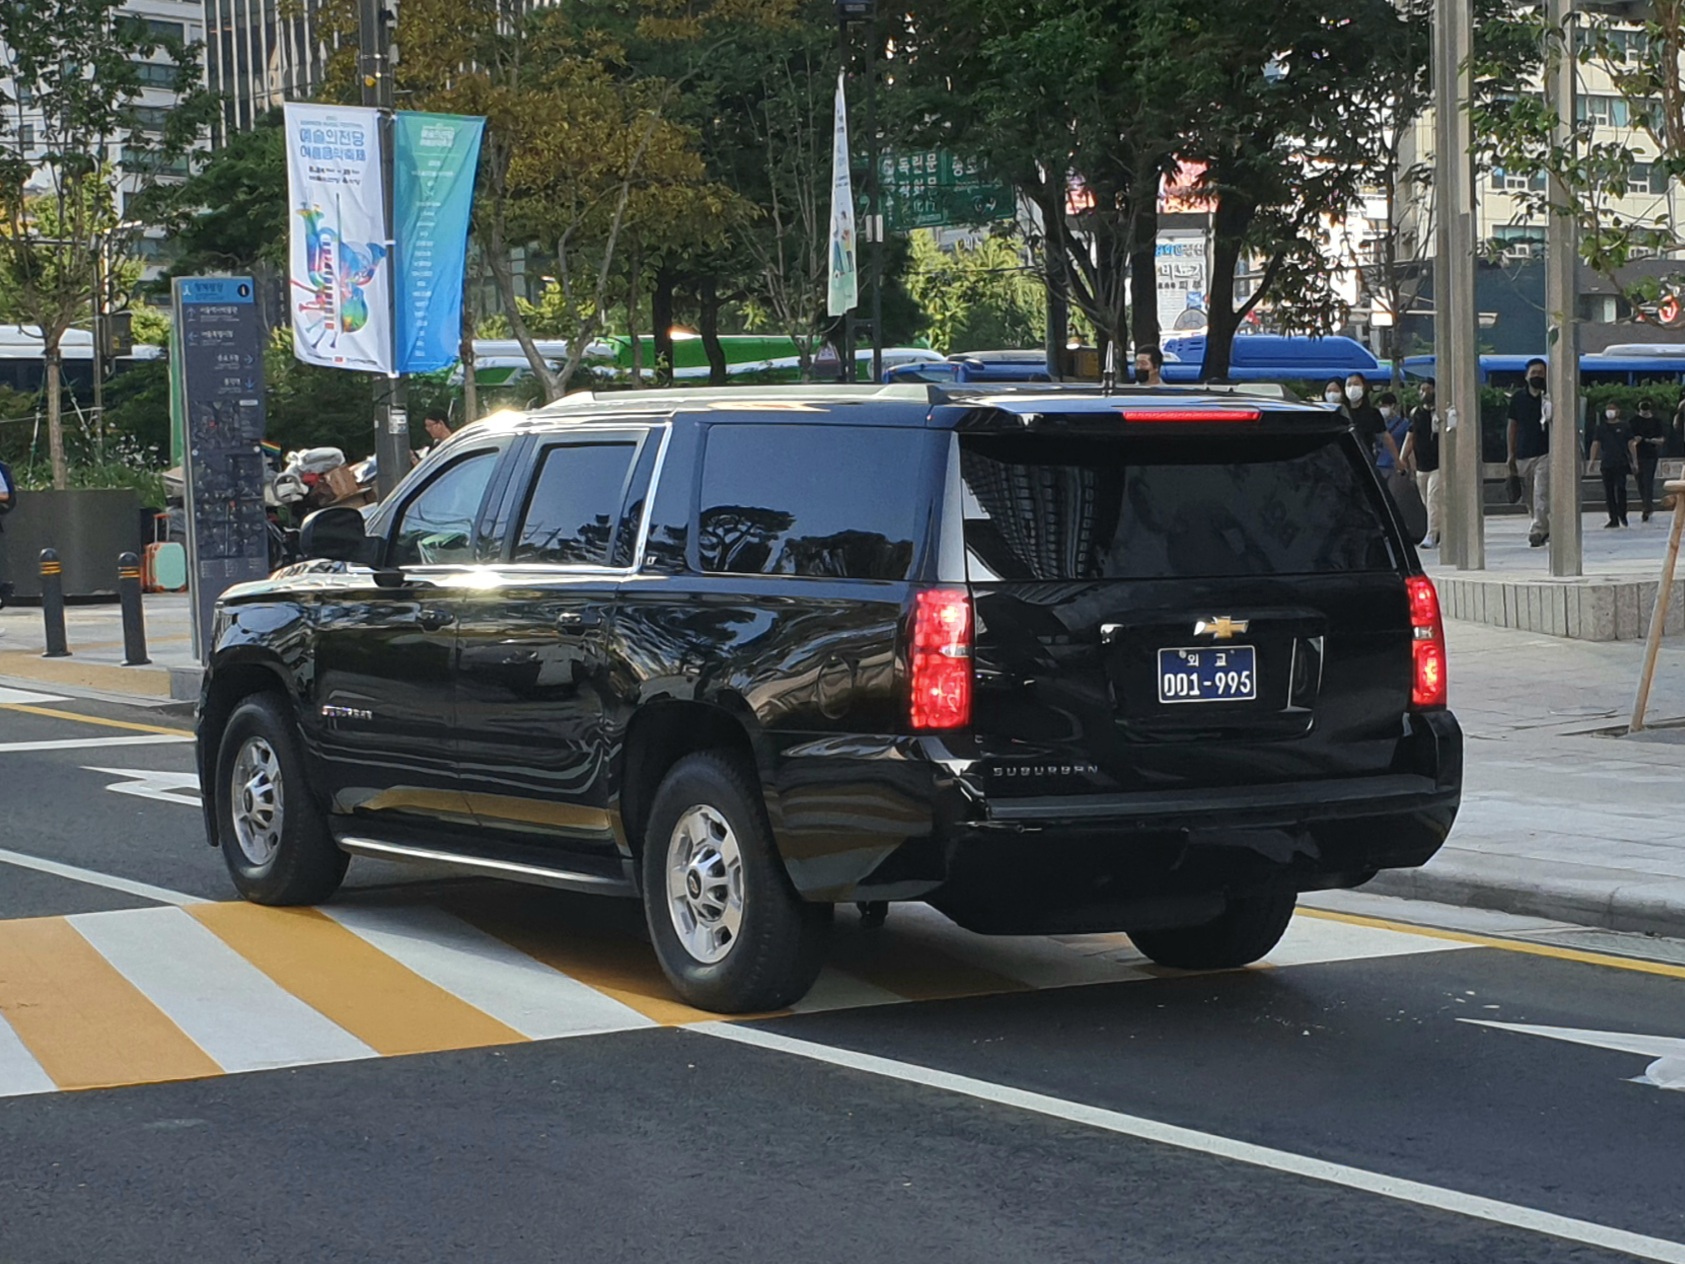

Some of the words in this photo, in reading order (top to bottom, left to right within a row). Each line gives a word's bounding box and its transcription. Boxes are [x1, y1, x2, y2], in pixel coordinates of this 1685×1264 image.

[300, 128, 365, 147] 예술의전당
[1163, 671, 1251, 696] 001-995
[992, 765, 1098, 777] SUBURBAN
